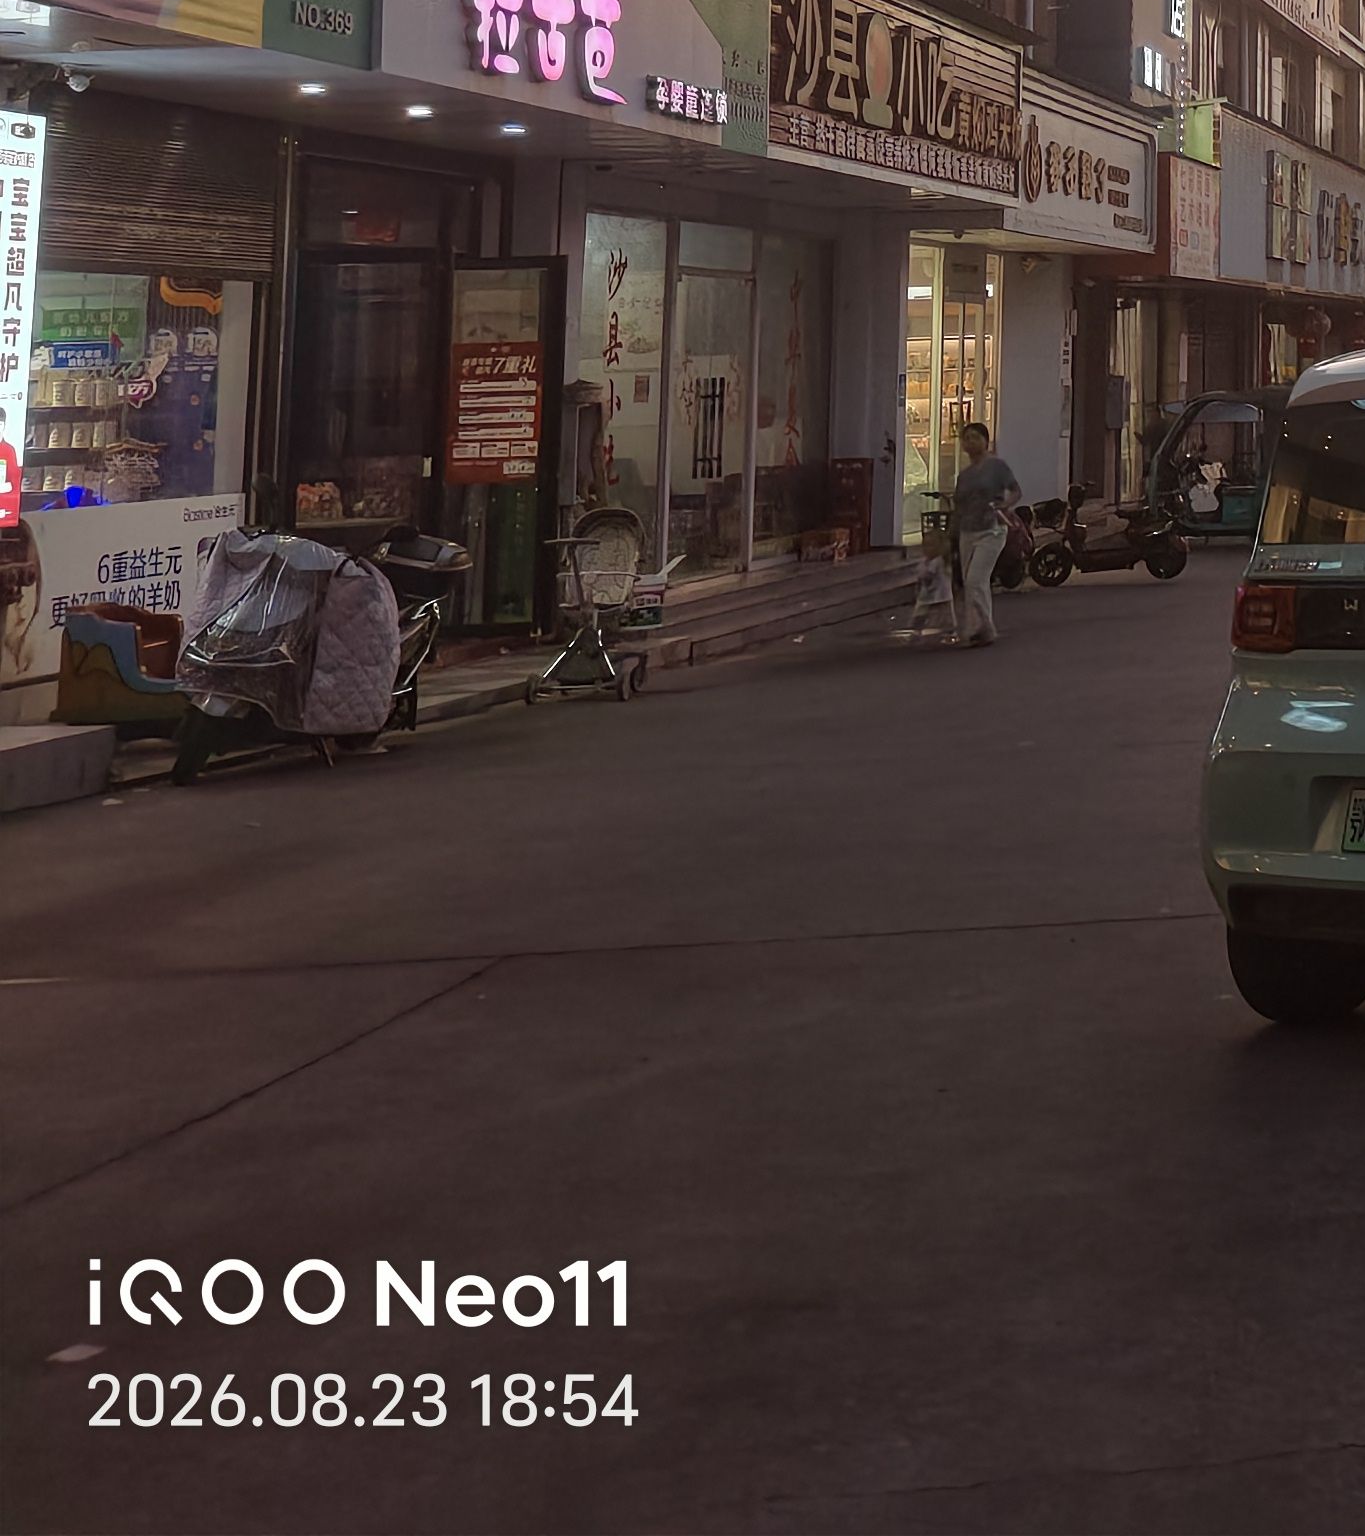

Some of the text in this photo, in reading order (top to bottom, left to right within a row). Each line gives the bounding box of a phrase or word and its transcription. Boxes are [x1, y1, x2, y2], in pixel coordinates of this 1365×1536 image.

[294, 0, 354, 36] NO.369
[656, 76, 728, 125] 孕婴童连锁
[98, 546, 182, 584] 6重益生元
